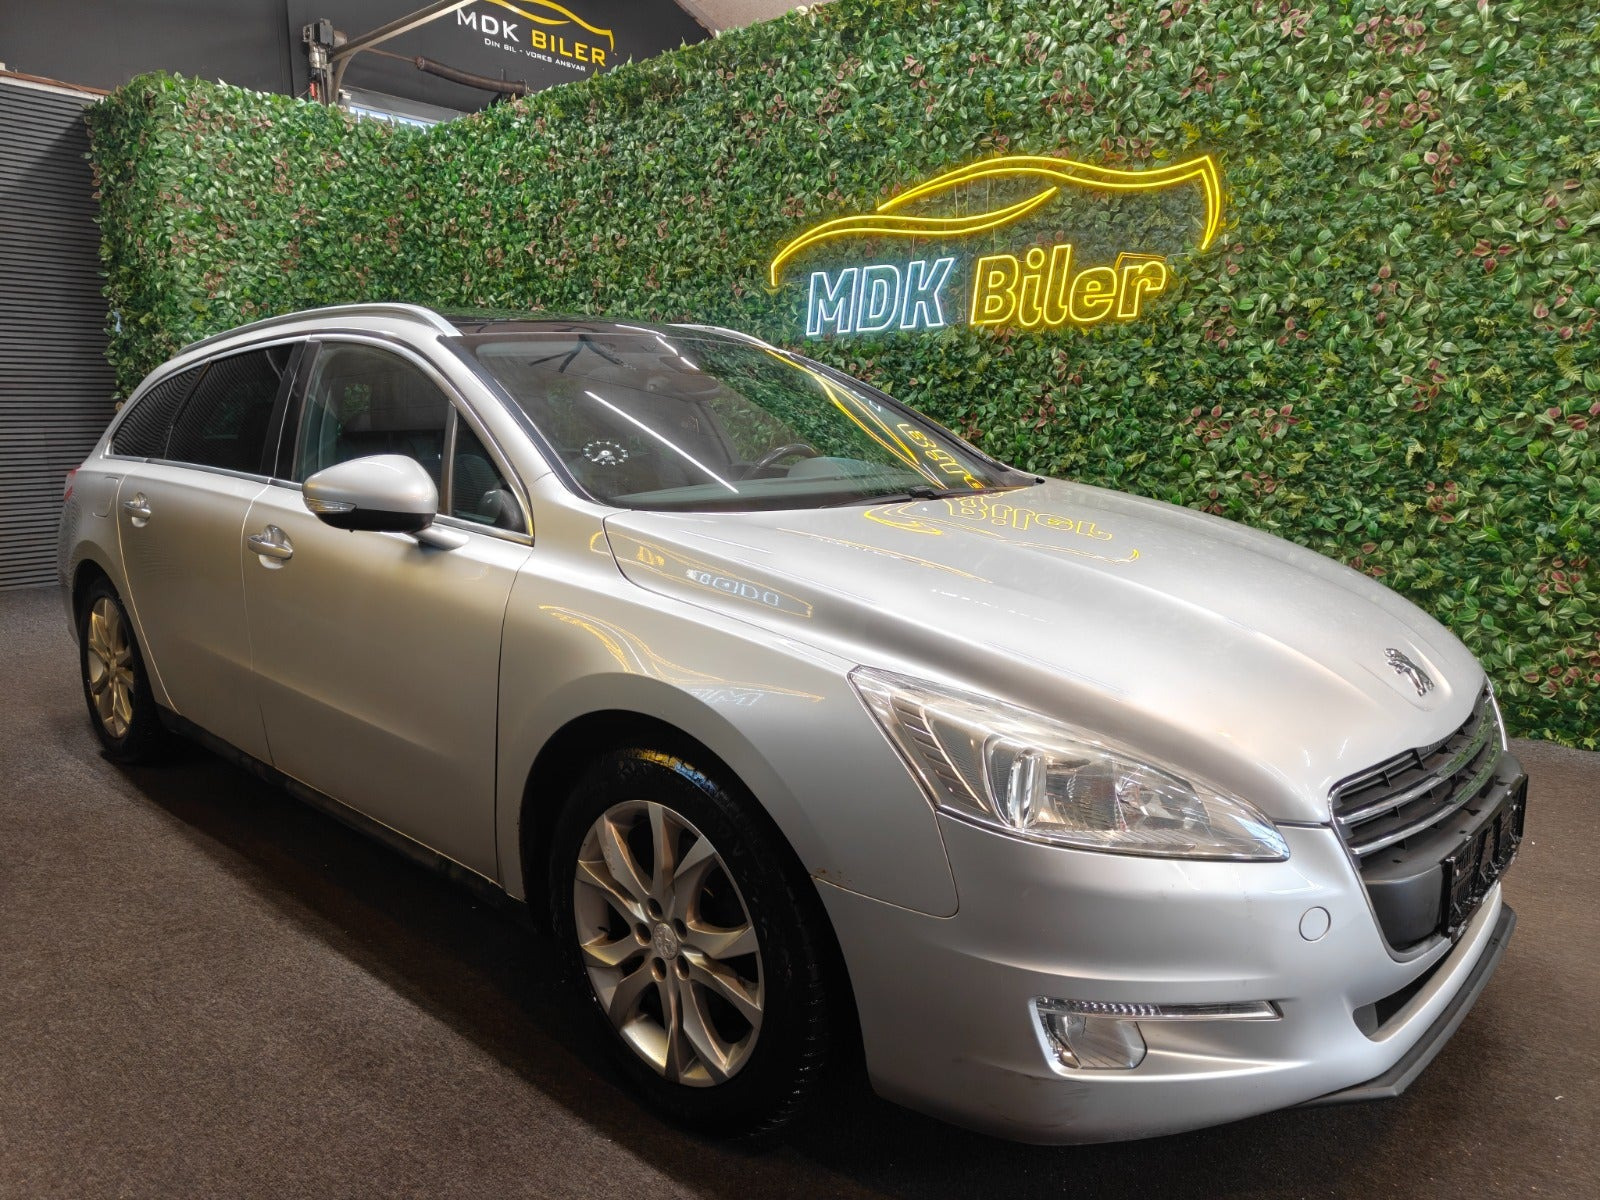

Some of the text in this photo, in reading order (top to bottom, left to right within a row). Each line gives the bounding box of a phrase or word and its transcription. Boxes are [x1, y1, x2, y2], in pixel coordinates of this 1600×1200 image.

[456, 8, 606, 67] MDK BILER
[525, 50, 553, 63] VORES
[555, 58, 586, 72] ANSVAR
[806, 243, 1169, 336] MDK Biler
